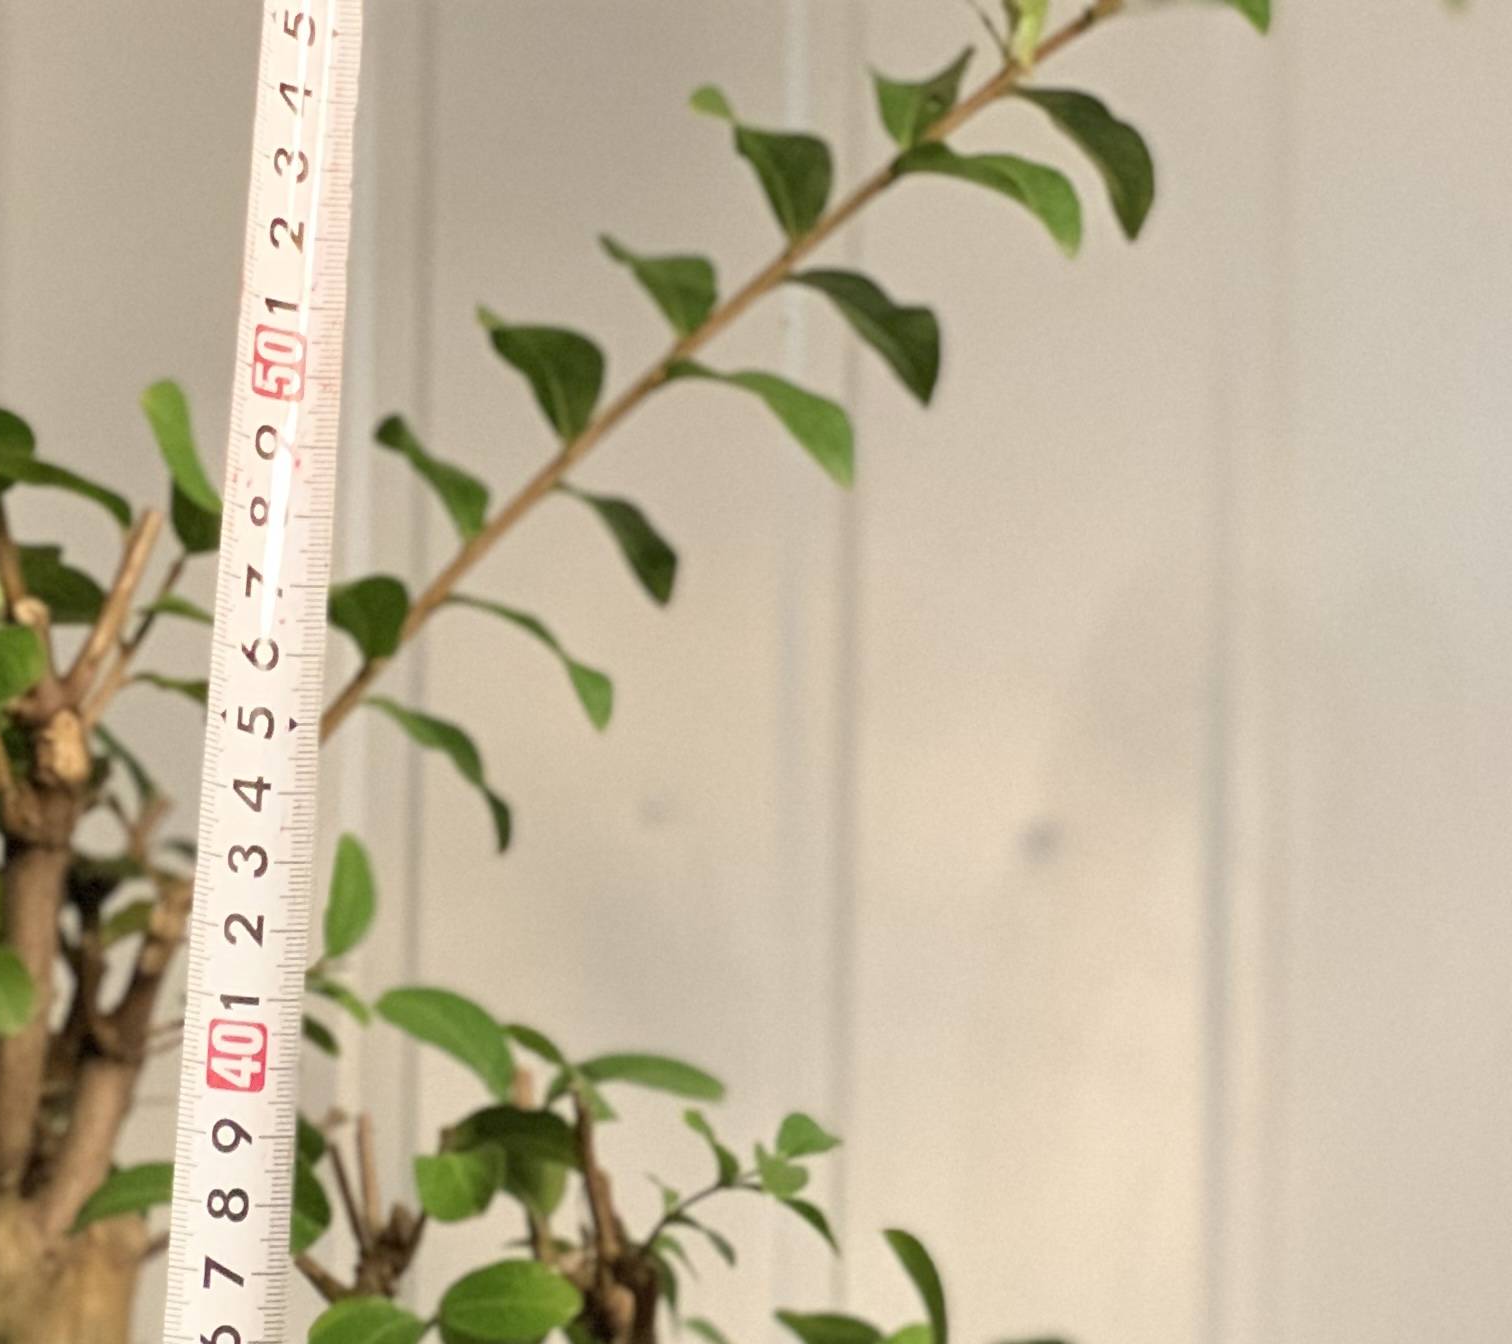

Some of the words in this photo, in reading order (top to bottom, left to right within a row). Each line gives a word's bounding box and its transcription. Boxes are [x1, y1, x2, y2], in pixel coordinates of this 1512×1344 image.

[284, 10, 316, 46] 5
[274, 147, 309, 183] 3
[270, 217, 304, 252] 2
[265, 297, 298, 313] 1
[254, 329, 304, 397] 50
[242, 638, 279, 671] 6
[237, 707, 274, 739] 5
[233, 777, 271, 812] 4
[228, 845, 268, 877] 3
[224, 914, 264, 946] 2
[220, 994, 259, 1010] 1
[209, 1023, 265, 1089] 40
[212, 1119, 252, 1153] 9
[207, 1188, 249, 1222] 8
[203, 1256, 244, 1288] 7
